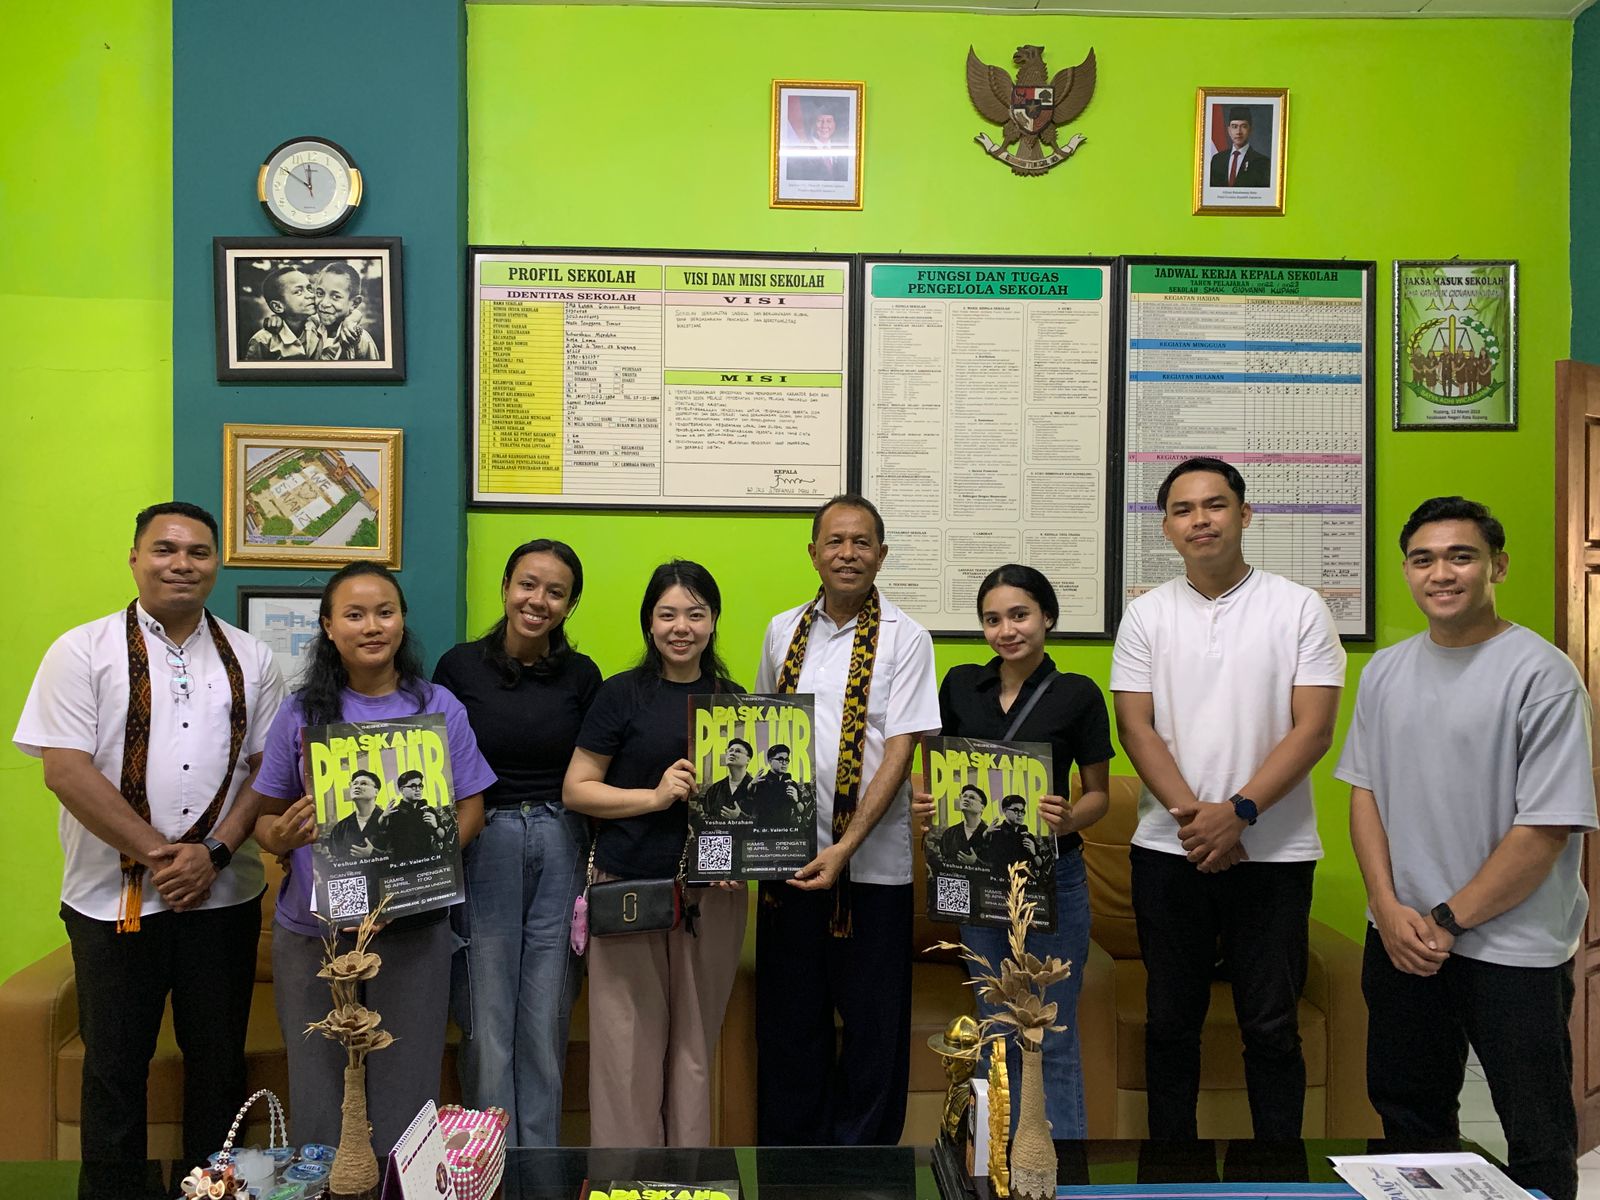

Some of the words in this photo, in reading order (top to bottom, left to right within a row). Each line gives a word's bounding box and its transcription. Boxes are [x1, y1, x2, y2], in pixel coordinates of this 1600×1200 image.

[508, 267, 563, 281] PROFIL
[567, 269, 636, 284] SEKOLAH
[684, 272, 708, 286] VISI
[712, 272, 735, 286] DAN
[739, 273, 766, 287] MISI
[770, 274, 824, 288] SEKOLAH
[918, 270, 972, 282] FUNGSI
[975, 271, 1006, 282] DAN
[1011, 271, 1059, 283] TUGAS
[1155, 268, 1198, 279] JADWAL
[1202, 269, 1237, 279] KERJA
[1241, 270, 1284, 281] KEPALA
[1287, 271, 1338, 281] SEKOLAH
[1404, 277, 1431, 285] JAKSA
[1433, 277, 1463, 285] MASUK
[1464, 277, 1504, 286] SEKOLAH
[908, 283, 995, 295] PENGELOLA
[999, 285, 1068, 295] SEKOLAH
[507, 290, 574, 299] IDENTITAS
[577, 292, 636, 301] SEKOLAH
[333, 860, 357, 868] Yeshua
[359, 856, 389, 864] Abraham
[409, 857, 430, 865] Valerio
[942, 862, 963, 870] Yeshua
[964, 865, 991, 873] Abraham
[384, 876, 404, 884] KAMIS
